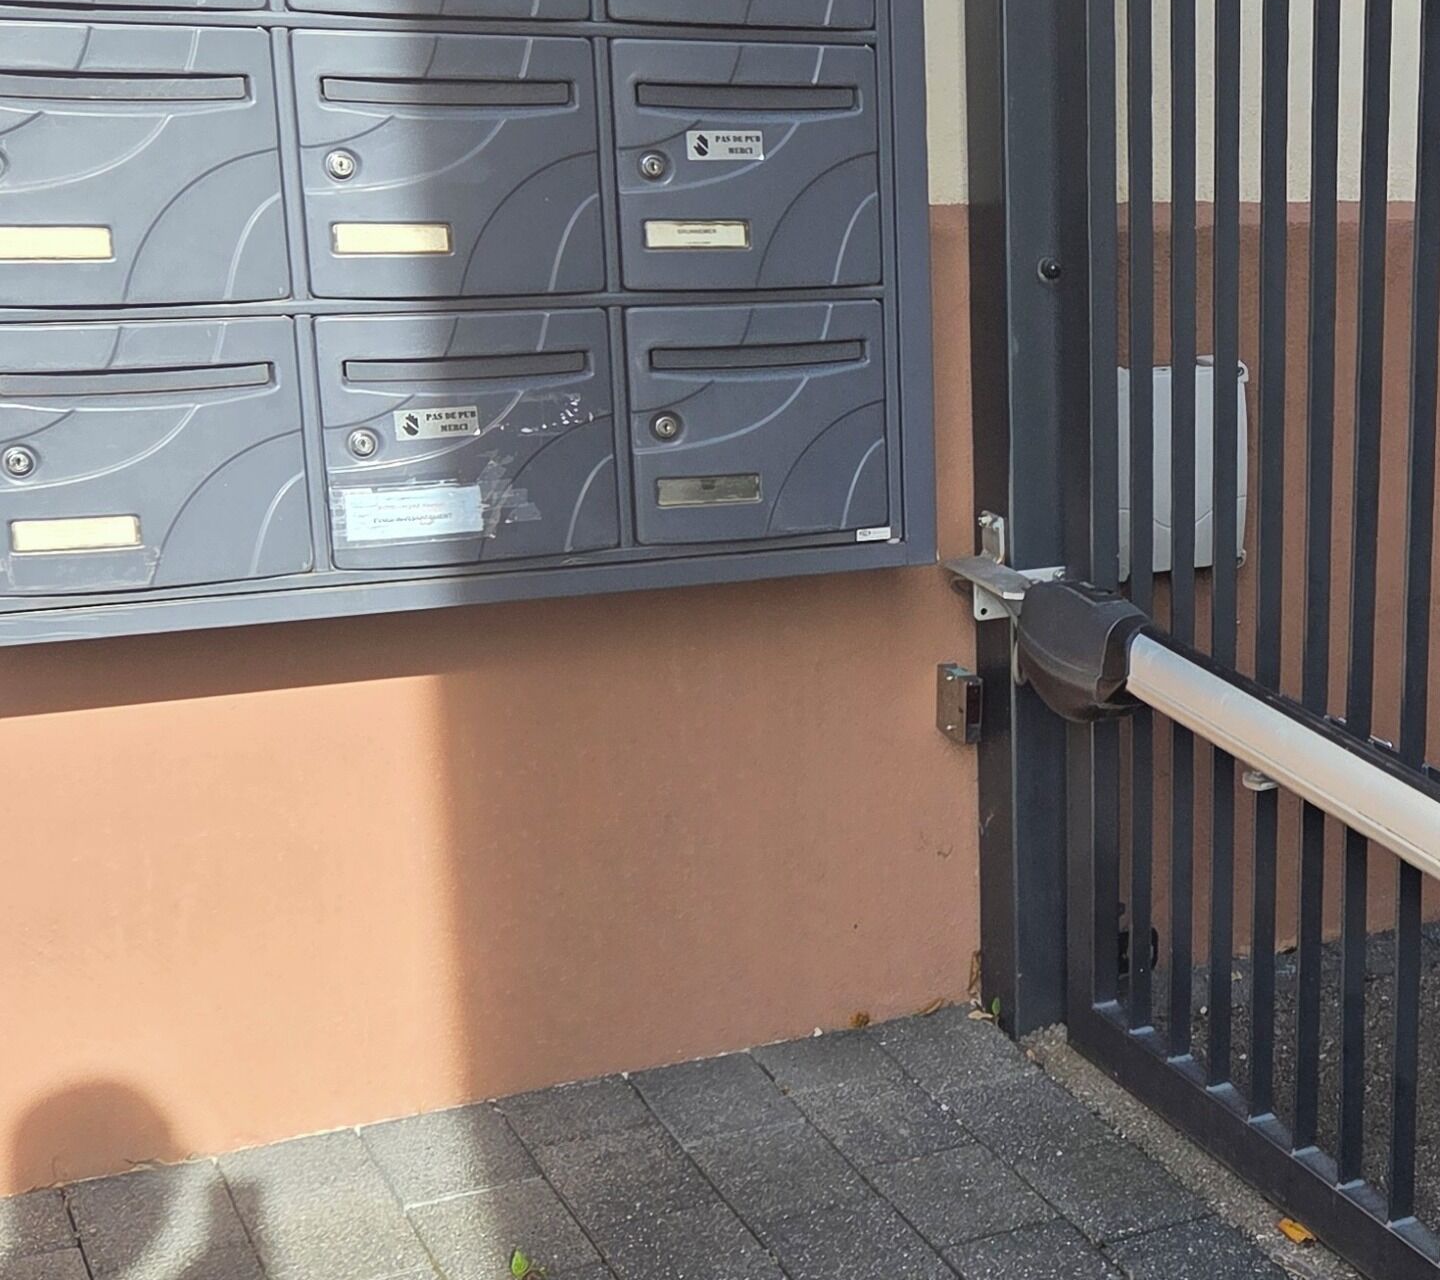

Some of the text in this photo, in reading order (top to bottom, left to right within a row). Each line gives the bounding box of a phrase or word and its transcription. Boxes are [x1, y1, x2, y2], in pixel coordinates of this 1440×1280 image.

[426, 412, 443, 421] PAS
[445, 411, 457, 420] DE
[440, 423, 469, 432] MERCI
